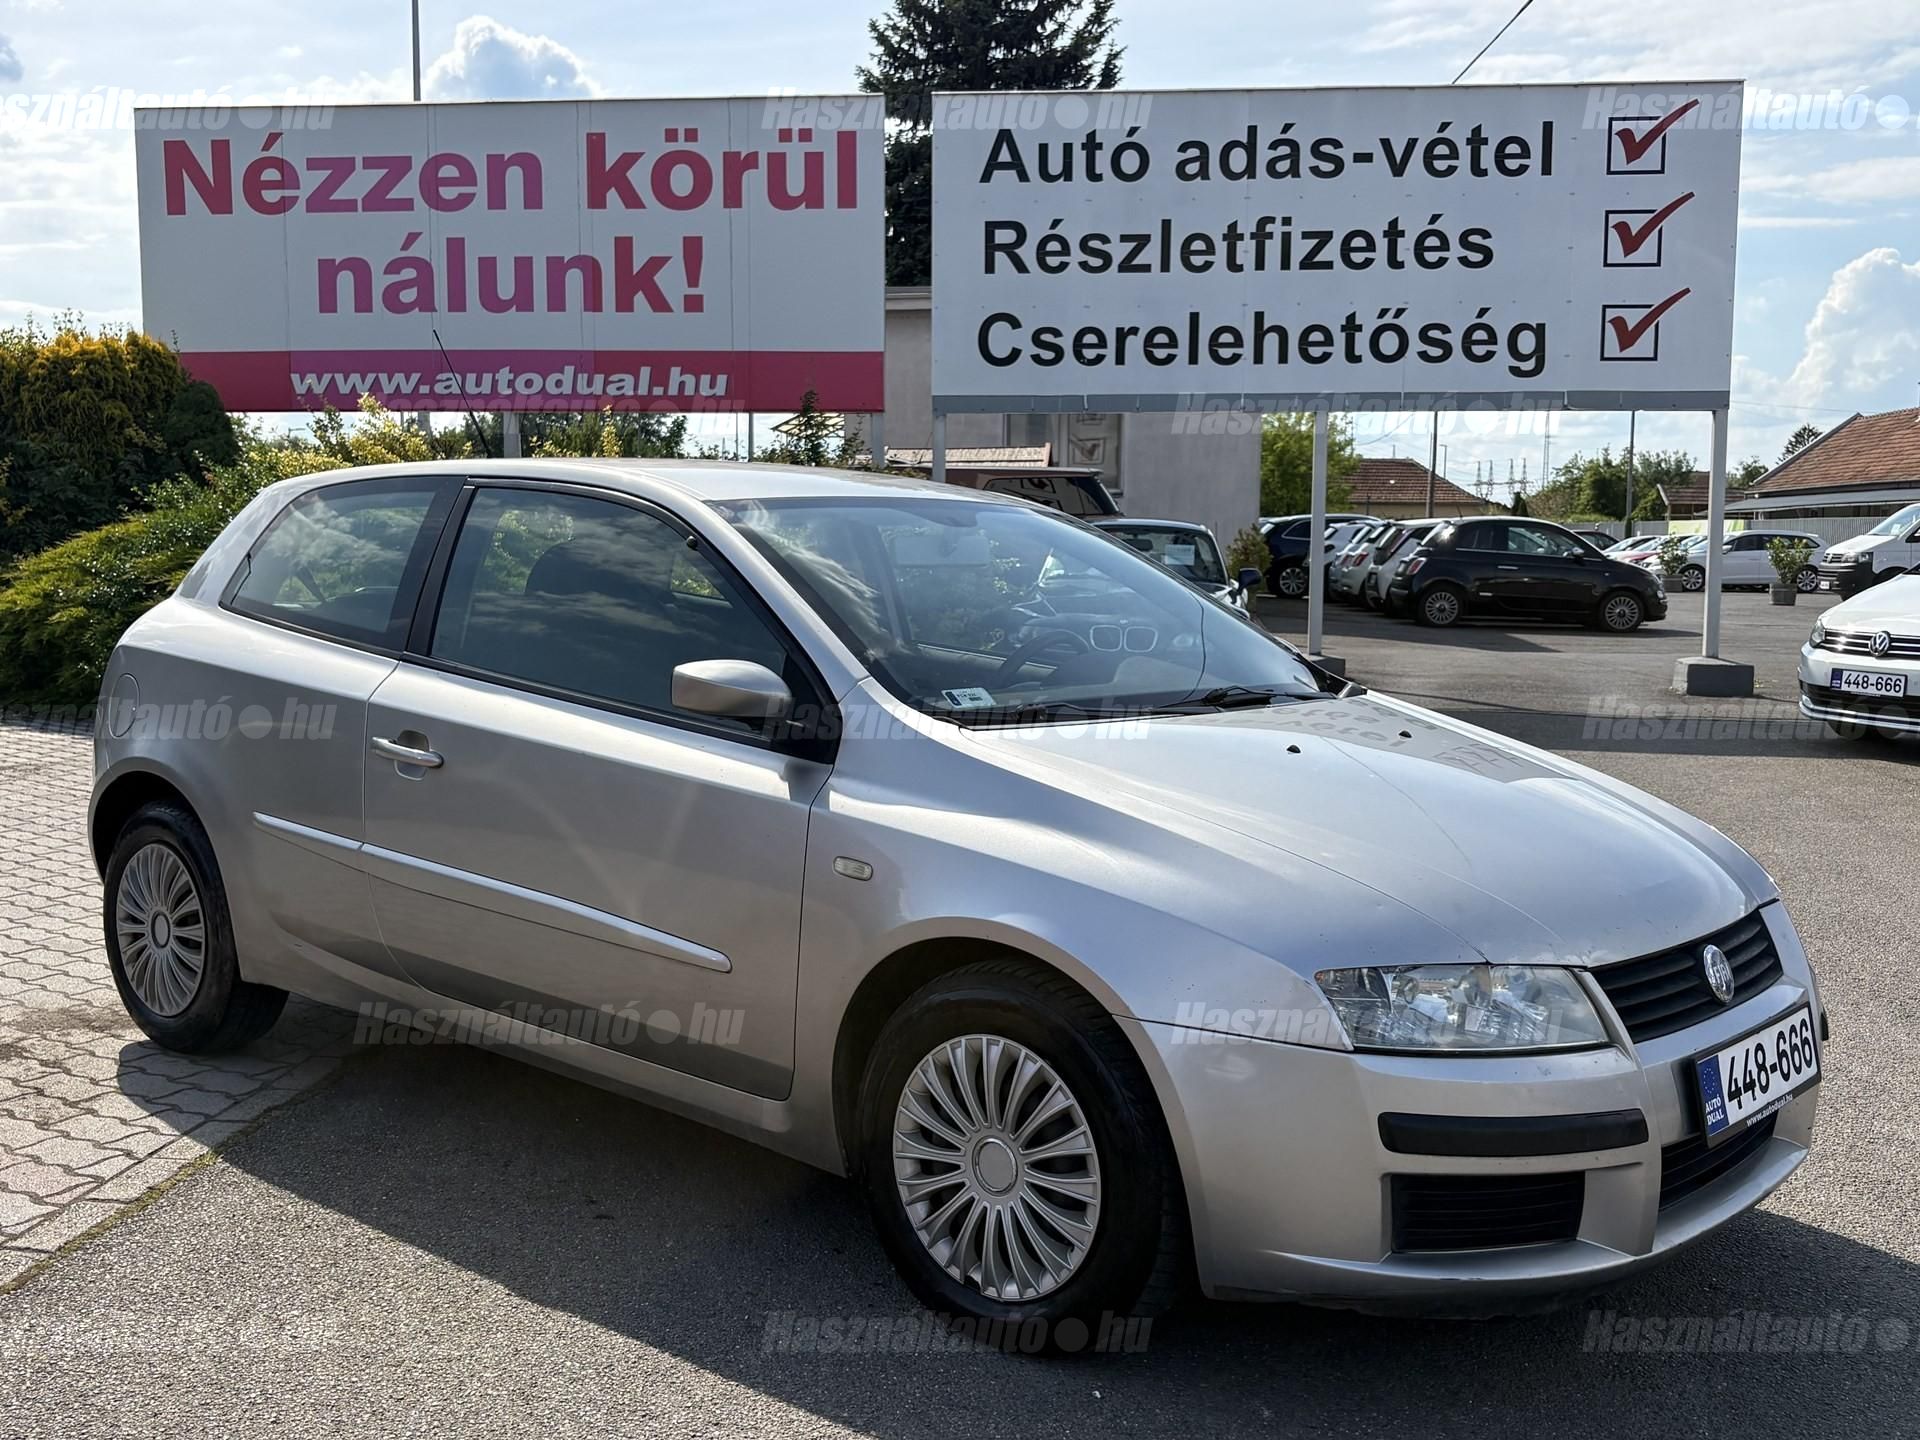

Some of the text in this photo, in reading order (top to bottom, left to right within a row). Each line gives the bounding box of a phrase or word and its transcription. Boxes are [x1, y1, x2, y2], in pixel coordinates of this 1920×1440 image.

[164, 128, 857, 215] Nézzen körül
[979, 120, 1554, 184] Autó adás-vétel
[318, 233, 704, 314] nálunk!
[984, 213, 1495, 275] Részletfizetés
[977, 307, 1547, 378] Cserelehetőség
[290, 365, 729, 397] www.autodual.hu
[1844, 673, 1903, 694] 448-666
[1727, 1018, 1812, 1110] 448-666
[1706, 1111, 1725, 1126] DUAL
